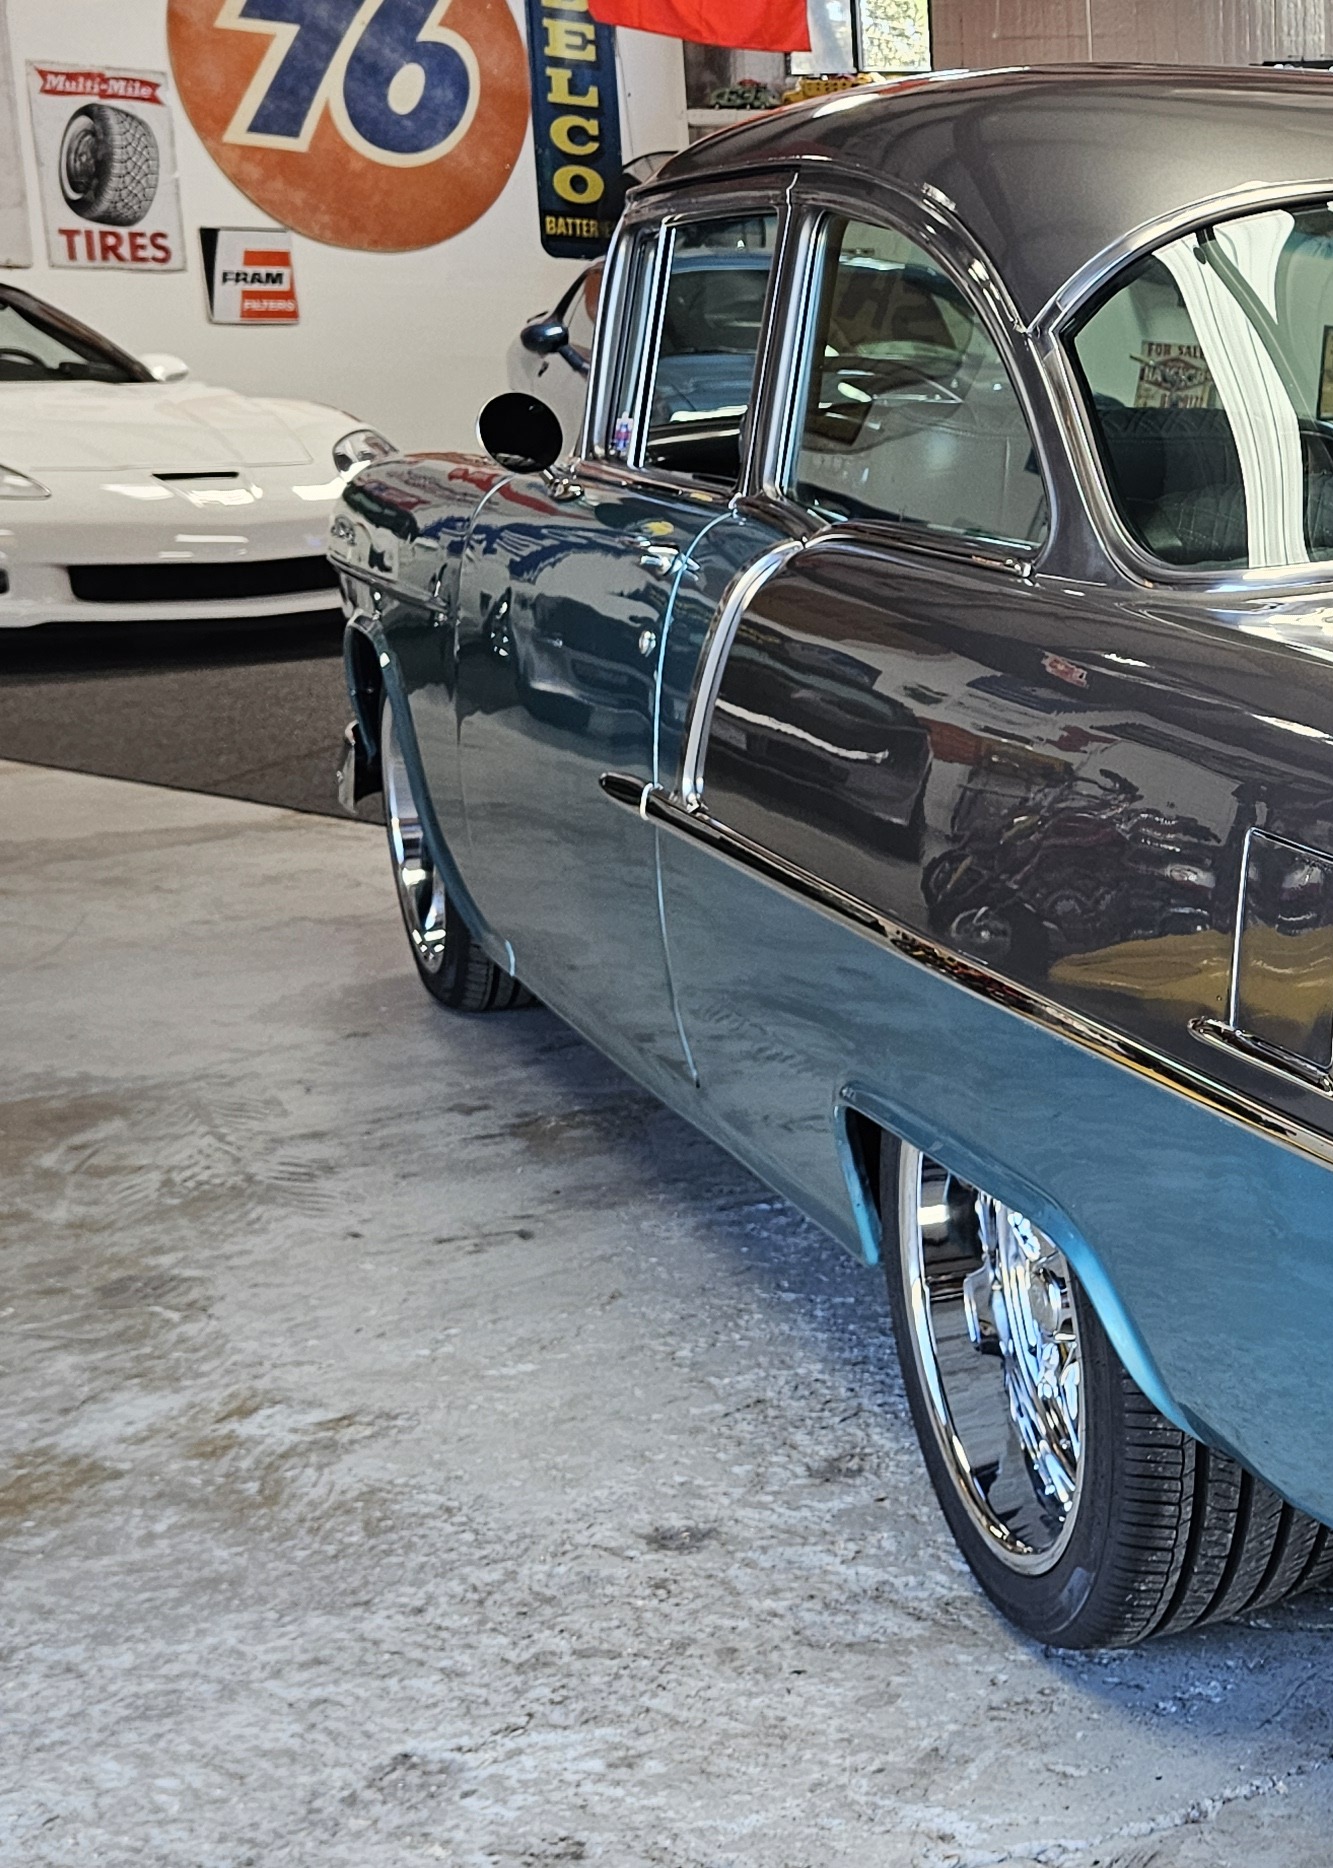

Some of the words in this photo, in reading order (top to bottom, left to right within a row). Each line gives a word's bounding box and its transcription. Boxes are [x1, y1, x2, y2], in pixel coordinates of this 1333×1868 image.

[45, 73, 153, 98] Multi-Mile
[213, 0, 480, 168] 76
[542, 0, 605, 204] ELCO
[58, 228, 172, 263] TIRES
[221, 270, 284, 285] FRAM
[243, 300, 295, 311] FILTERS
[1147, 342, 1171, 357] FOR
